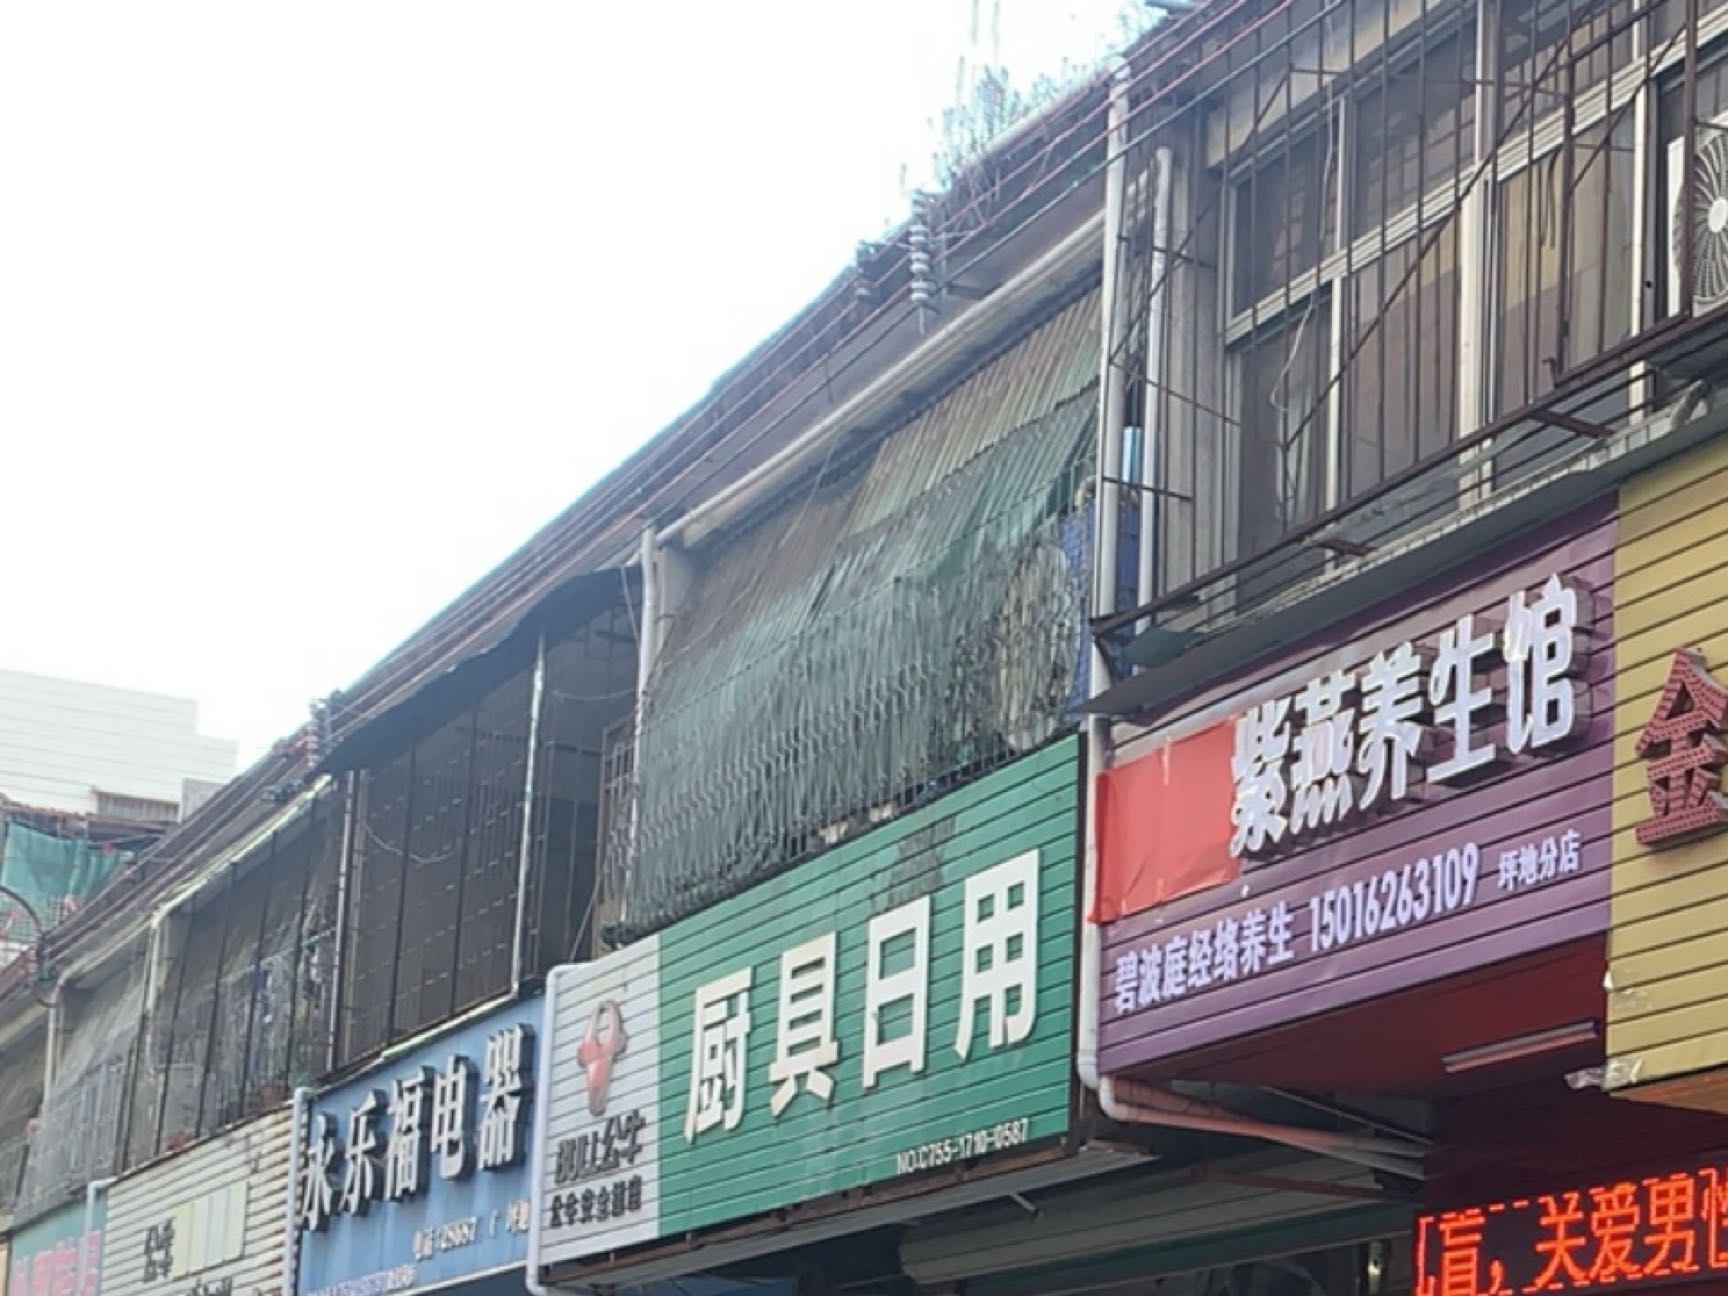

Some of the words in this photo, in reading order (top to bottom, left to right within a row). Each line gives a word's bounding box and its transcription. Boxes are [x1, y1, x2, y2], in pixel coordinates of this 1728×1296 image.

[1229, 573, 1585, 858] 紫燕养生馆
[684, 848, 1040, 1145] 厨具日用
[1114, 899, 1296, 1015] 碧波庭经络养生
[1309, 841, 1480, 952] 15016263109
[1496, 828, 1583, 890] 坪地分店
[300, 1023, 534, 1235] 永乐福电器
